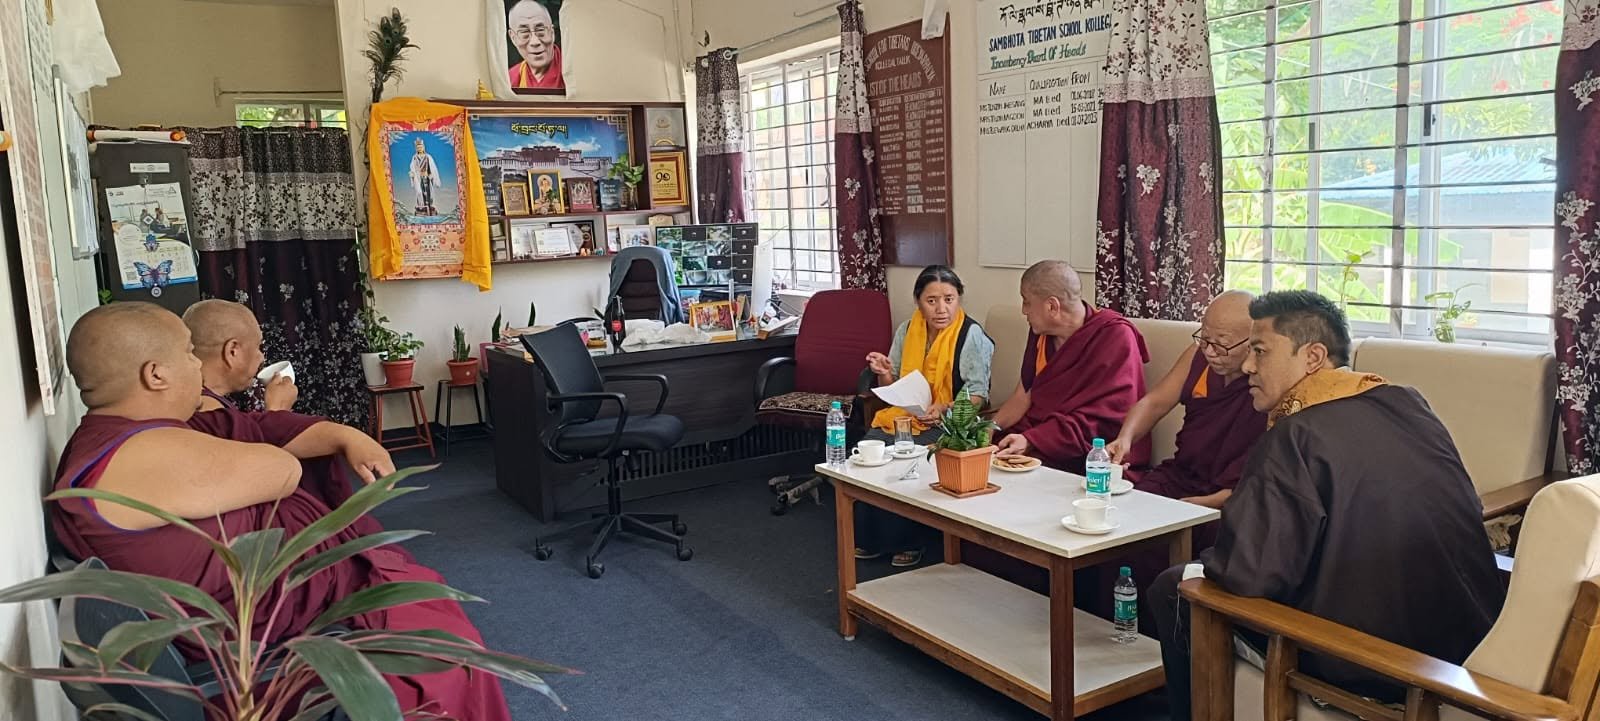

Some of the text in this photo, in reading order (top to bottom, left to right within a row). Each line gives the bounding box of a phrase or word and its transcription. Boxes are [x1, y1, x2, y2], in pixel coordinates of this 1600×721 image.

[989, 13, 1112, 52] SAMBHOTA TIBETAN SCHOOL KOLLEG
